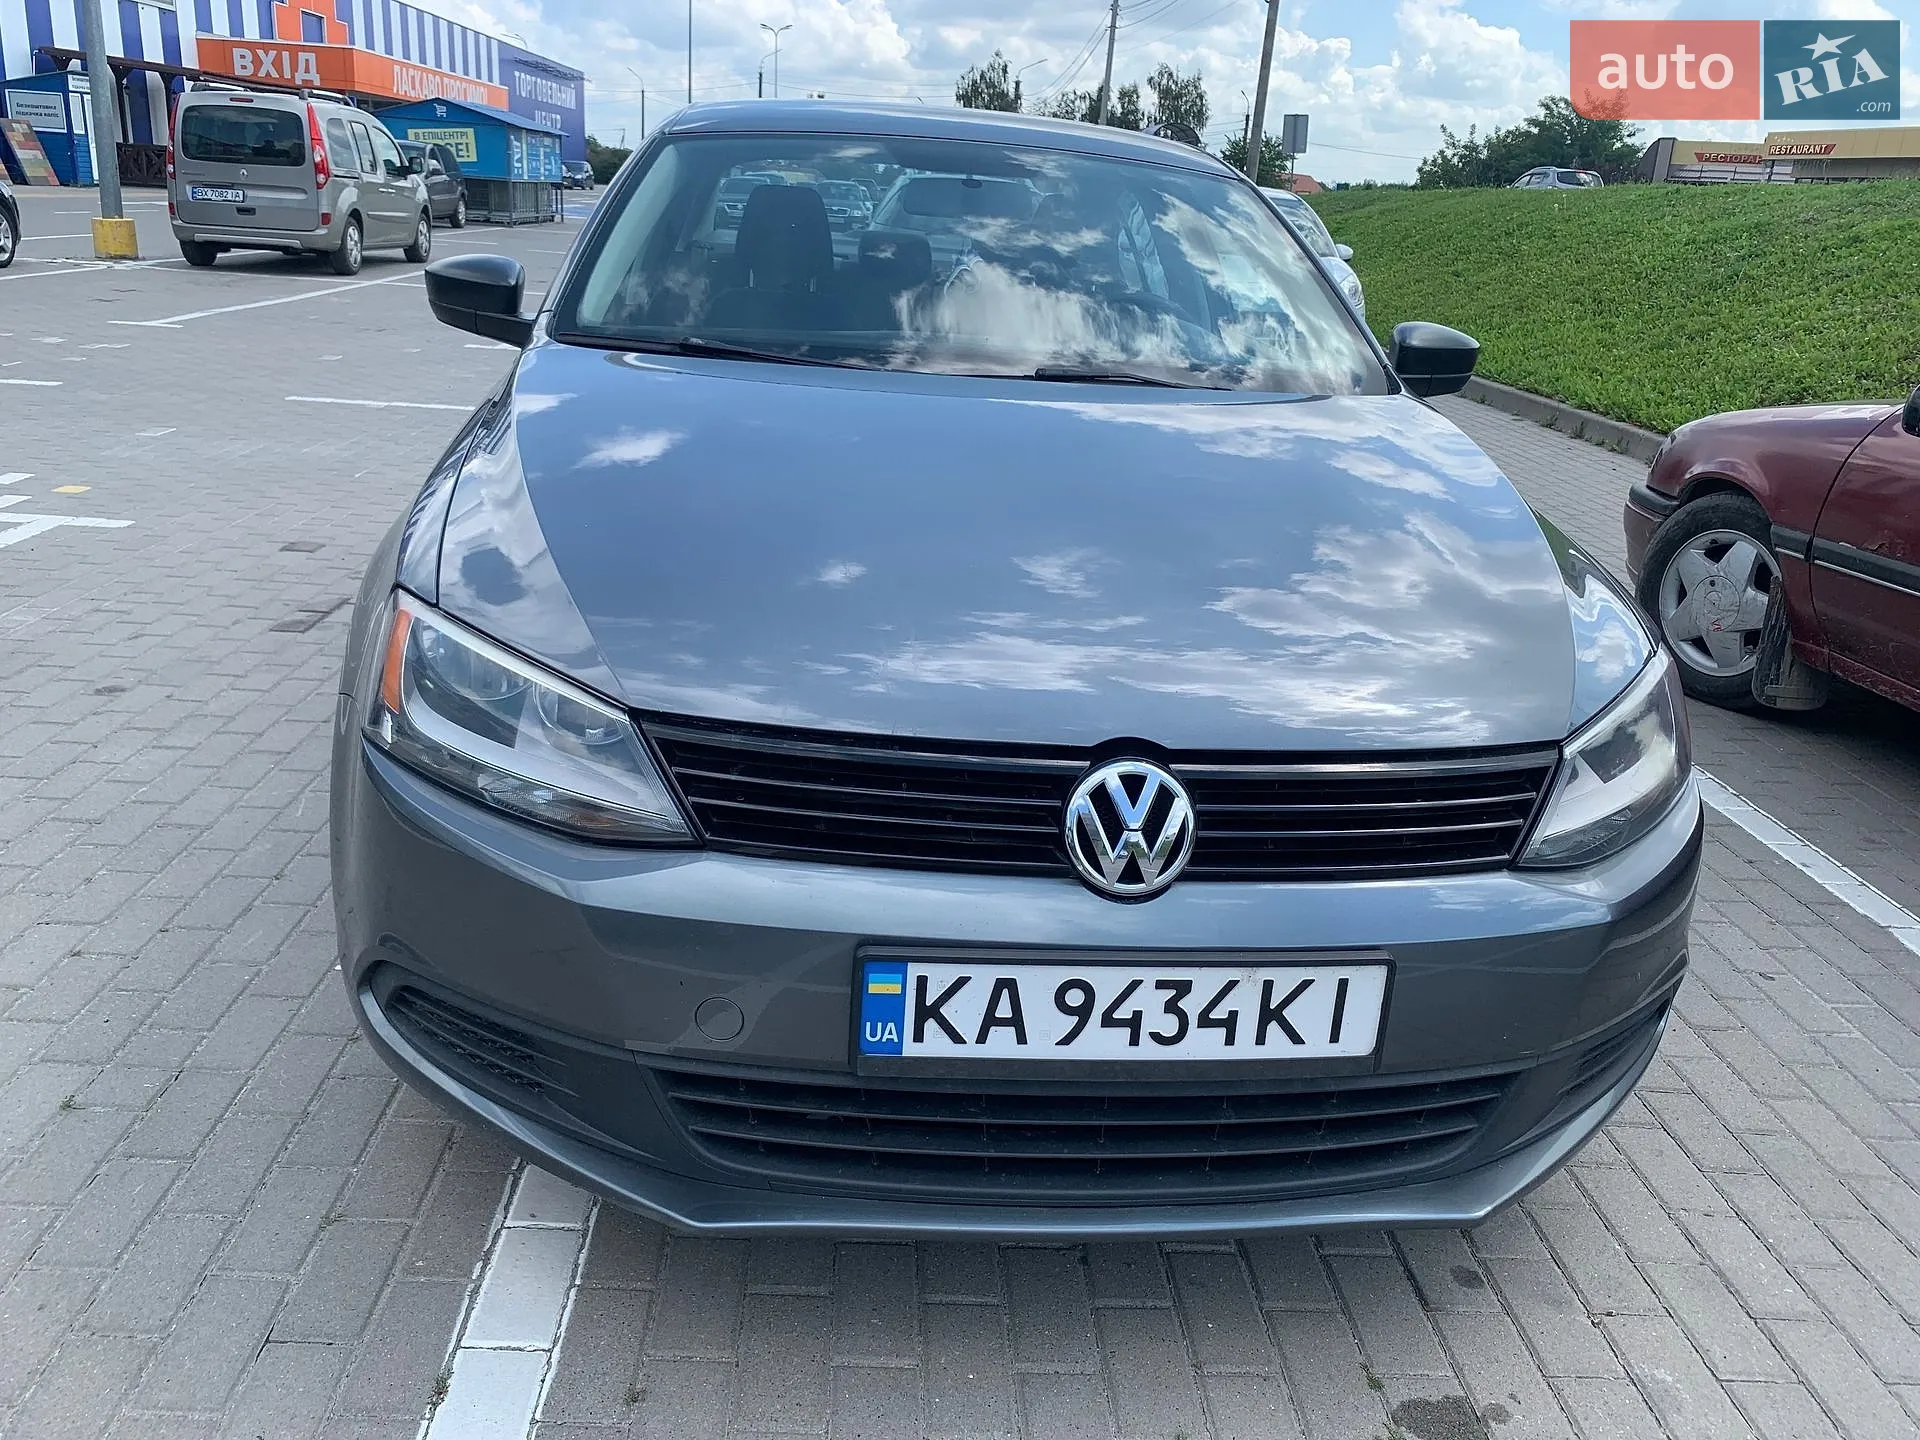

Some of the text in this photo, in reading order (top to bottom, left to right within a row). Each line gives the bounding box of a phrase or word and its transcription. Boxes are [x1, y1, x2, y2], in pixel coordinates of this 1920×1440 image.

[232, 48, 321, 85] ВХІД
[393, 65, 441, 99] ЛАСКАВО
[414, 131, 469, 141] В ЕПІЦЕНТРІ
[1769, 144, 1827, 156] RESTAURANT
[912, 974, 1353, 1047] KA 9434 KI
[865, 1022, 899, 1043] UA
